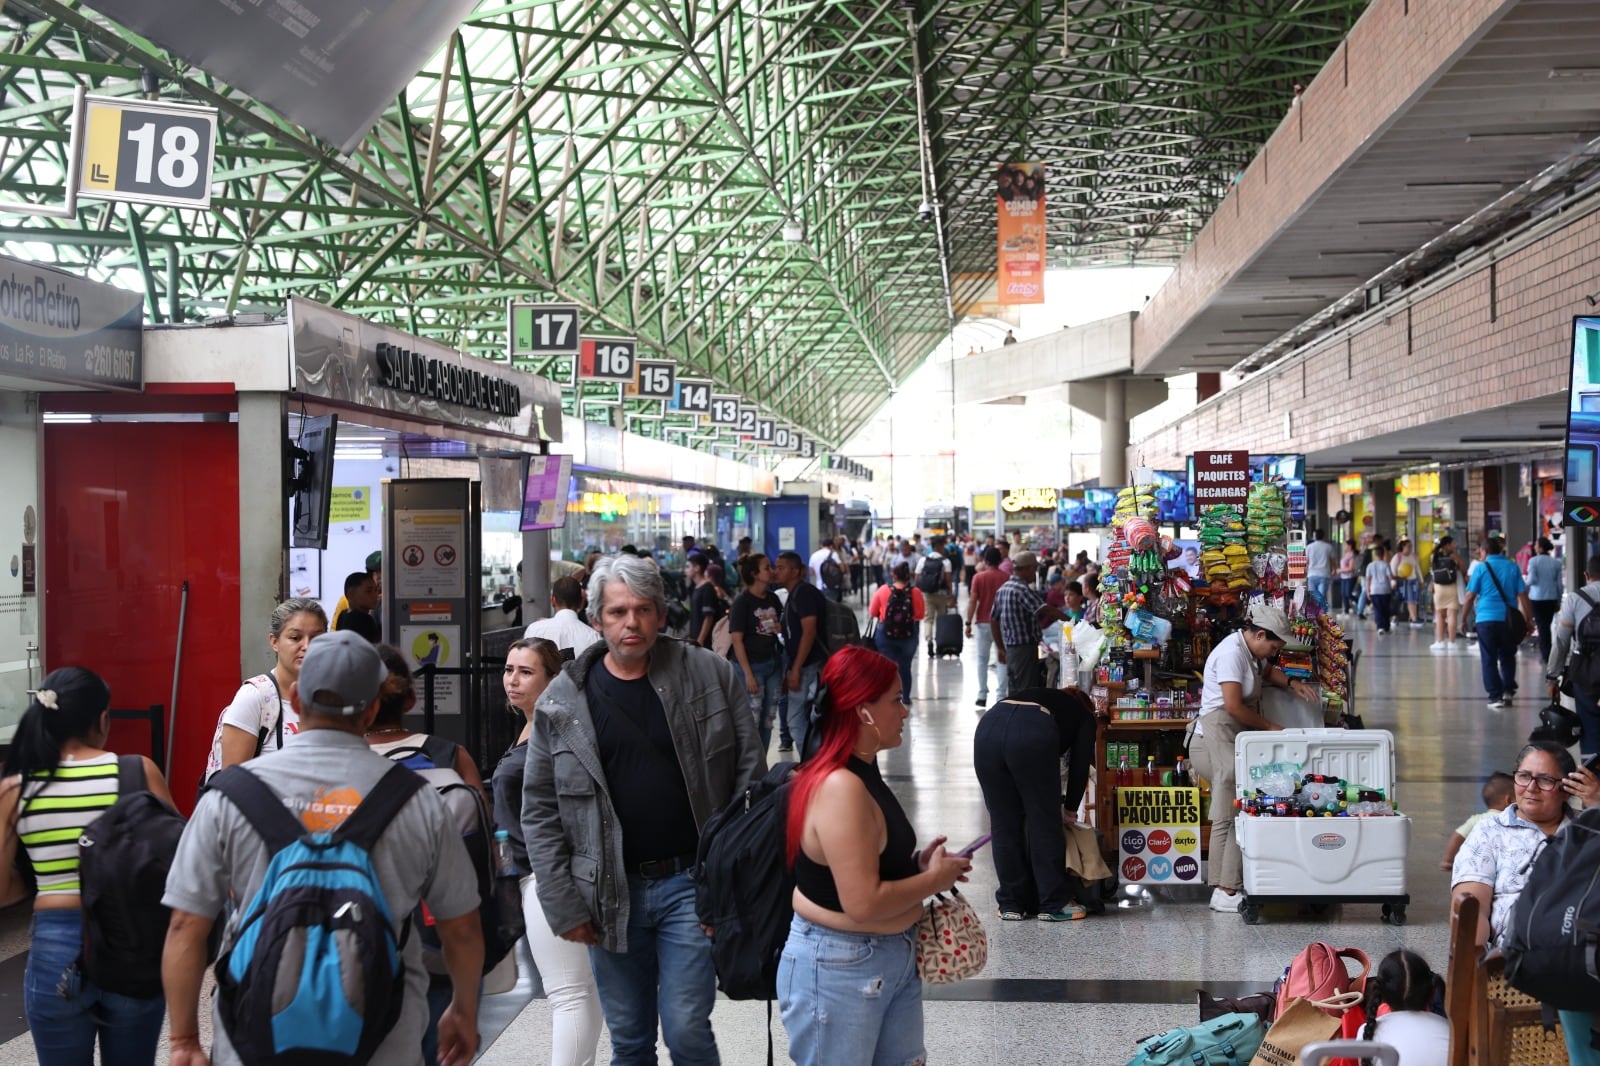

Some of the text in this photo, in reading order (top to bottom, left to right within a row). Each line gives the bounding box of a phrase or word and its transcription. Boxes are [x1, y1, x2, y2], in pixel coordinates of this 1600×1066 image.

[127, 122, 199, 188] 18
[535, 314, 573, 346] 17
[93, 345, 112, 377] 260
[113, 349, 135, 381] 6067
[597, 346, 630, 375] 16
[378, 343, 416, 393] SALA
[415, 353, 434, 397] DE
[435, 360, 488, 409] ABORDAJE
[641, 368, 670, 393] 15
[682, 386, 707, 409] 14
[713, 400, 736, 422] 13
[741, 411, 755, 431] 2
[776, 430, 788, 447] 0
[831, 456, 841, 469] 7
[1210, 453, 1233, 465] CAFÉ
[1197, 471, 1246, 482] PAQUETES
[1196, 487, 1247, 498] RECARGAS
[1124, 790, 1192, 807] VENTA DE
[1120, 806, 1198, 825] PAQUETES
[1175, 863, 1196, 873] WOM
